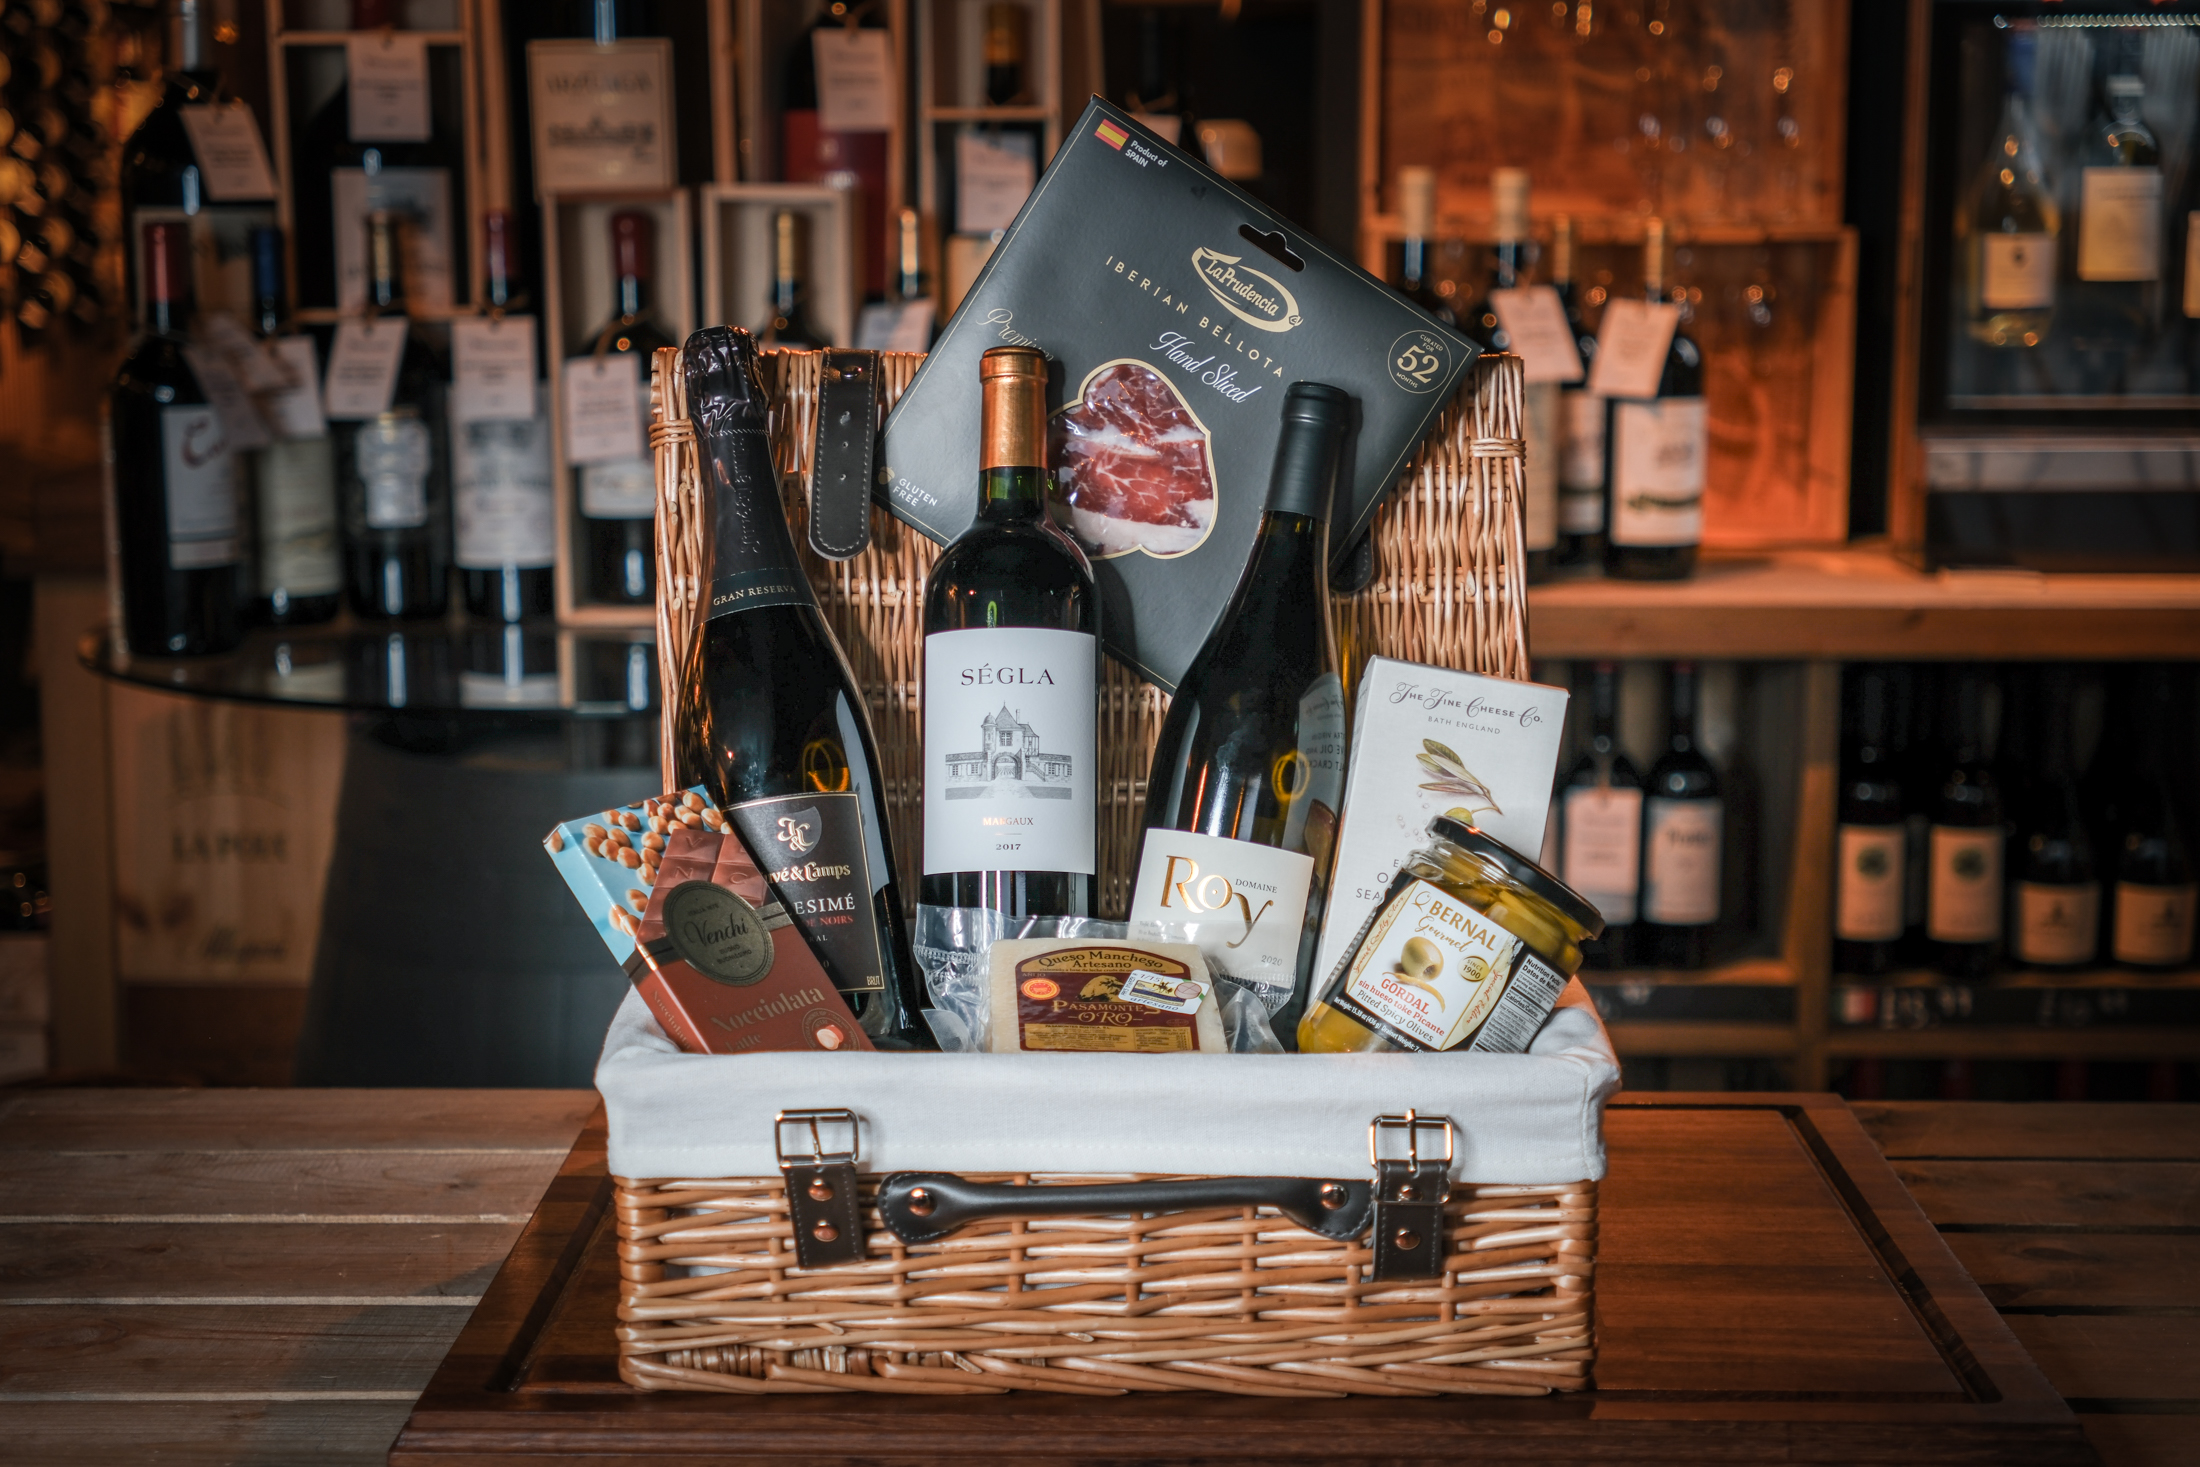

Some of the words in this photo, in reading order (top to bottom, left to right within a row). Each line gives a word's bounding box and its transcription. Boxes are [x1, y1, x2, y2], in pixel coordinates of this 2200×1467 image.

[1125, 149, 1148, 167] SPAIN
[1130, 140, 1158, 162] Product
[1157, 159, 1168, 167] of
[1105, 255, 1189, 314] IBERIAN
[1199, 316, 1283, 378] BELLOTA
[1420, 333, 1444, 351] CURATED
[1422, 342, 1435, 352] FOR
[1149, 331, 1215, 373] Hand
[1201, 363, 1262, 403] Sliced
[1397, 345, 1439, 383] 52
[1396, 372, 1418, 388] MONTHS
[892, 486, 919, 507] FREE
[899, 478, 938, 507] GLUTEN
[713, 588, 745, 606] GRAN
[748, 584, 796, 597] RESERVA
[960, 662, 1055, 686] SÉGLA
[1427, 715, 1452, 726] BATH
[1456, 721, 1501, 735] ENGLAND
[983, 817, 1034, 826] MARGAUX
[995, 843, 1022, 851] 2017
[1235, 878, 1278, 893] DOMAINE
[684, 912, 749, 947] Venchi
[820, 915, 854, 926] NOIRS
[1429, 900, 1497, 952] BERNAL
[1414, 914, 1473, 952] Gourmet
[1039, 954, 1085, 968] Queso
[1089, 951, 1164, 968] Manchego
[1072, 960, 1132, 969] Artesano
[1260, 954, 1283, 967] 2020
[1466, 959, 1483, 971] SINCE
[1526, 958, 1552, 978] Nutrition
[866, 975, 881, 986] BRUT
[1463, 964, 1482, 979] 1900
[1522, 965, 1540, 981] Datos
[1539, 976, 1548, 985] de
[1130, 997, 1179, 1011] artesano
[1381, 978, 1429, 1015] GORDAL
[710, 987, 826, 1032] Nocciolata
[1357, 989, 1381, 1009] Pitted
[1380, 1004, 1406, 1025] Spicy
[1406, 1020, 1434, 1042] Olives
[1358, 980, 1369, 990] sin
[1369, 985, 1394, 1004] hueso
[1394, 1000, 1413, 1016] toke
[1412, 1011, 1445, 1037] Picante
[1397, 1034, 1415, 1050] Weight:
